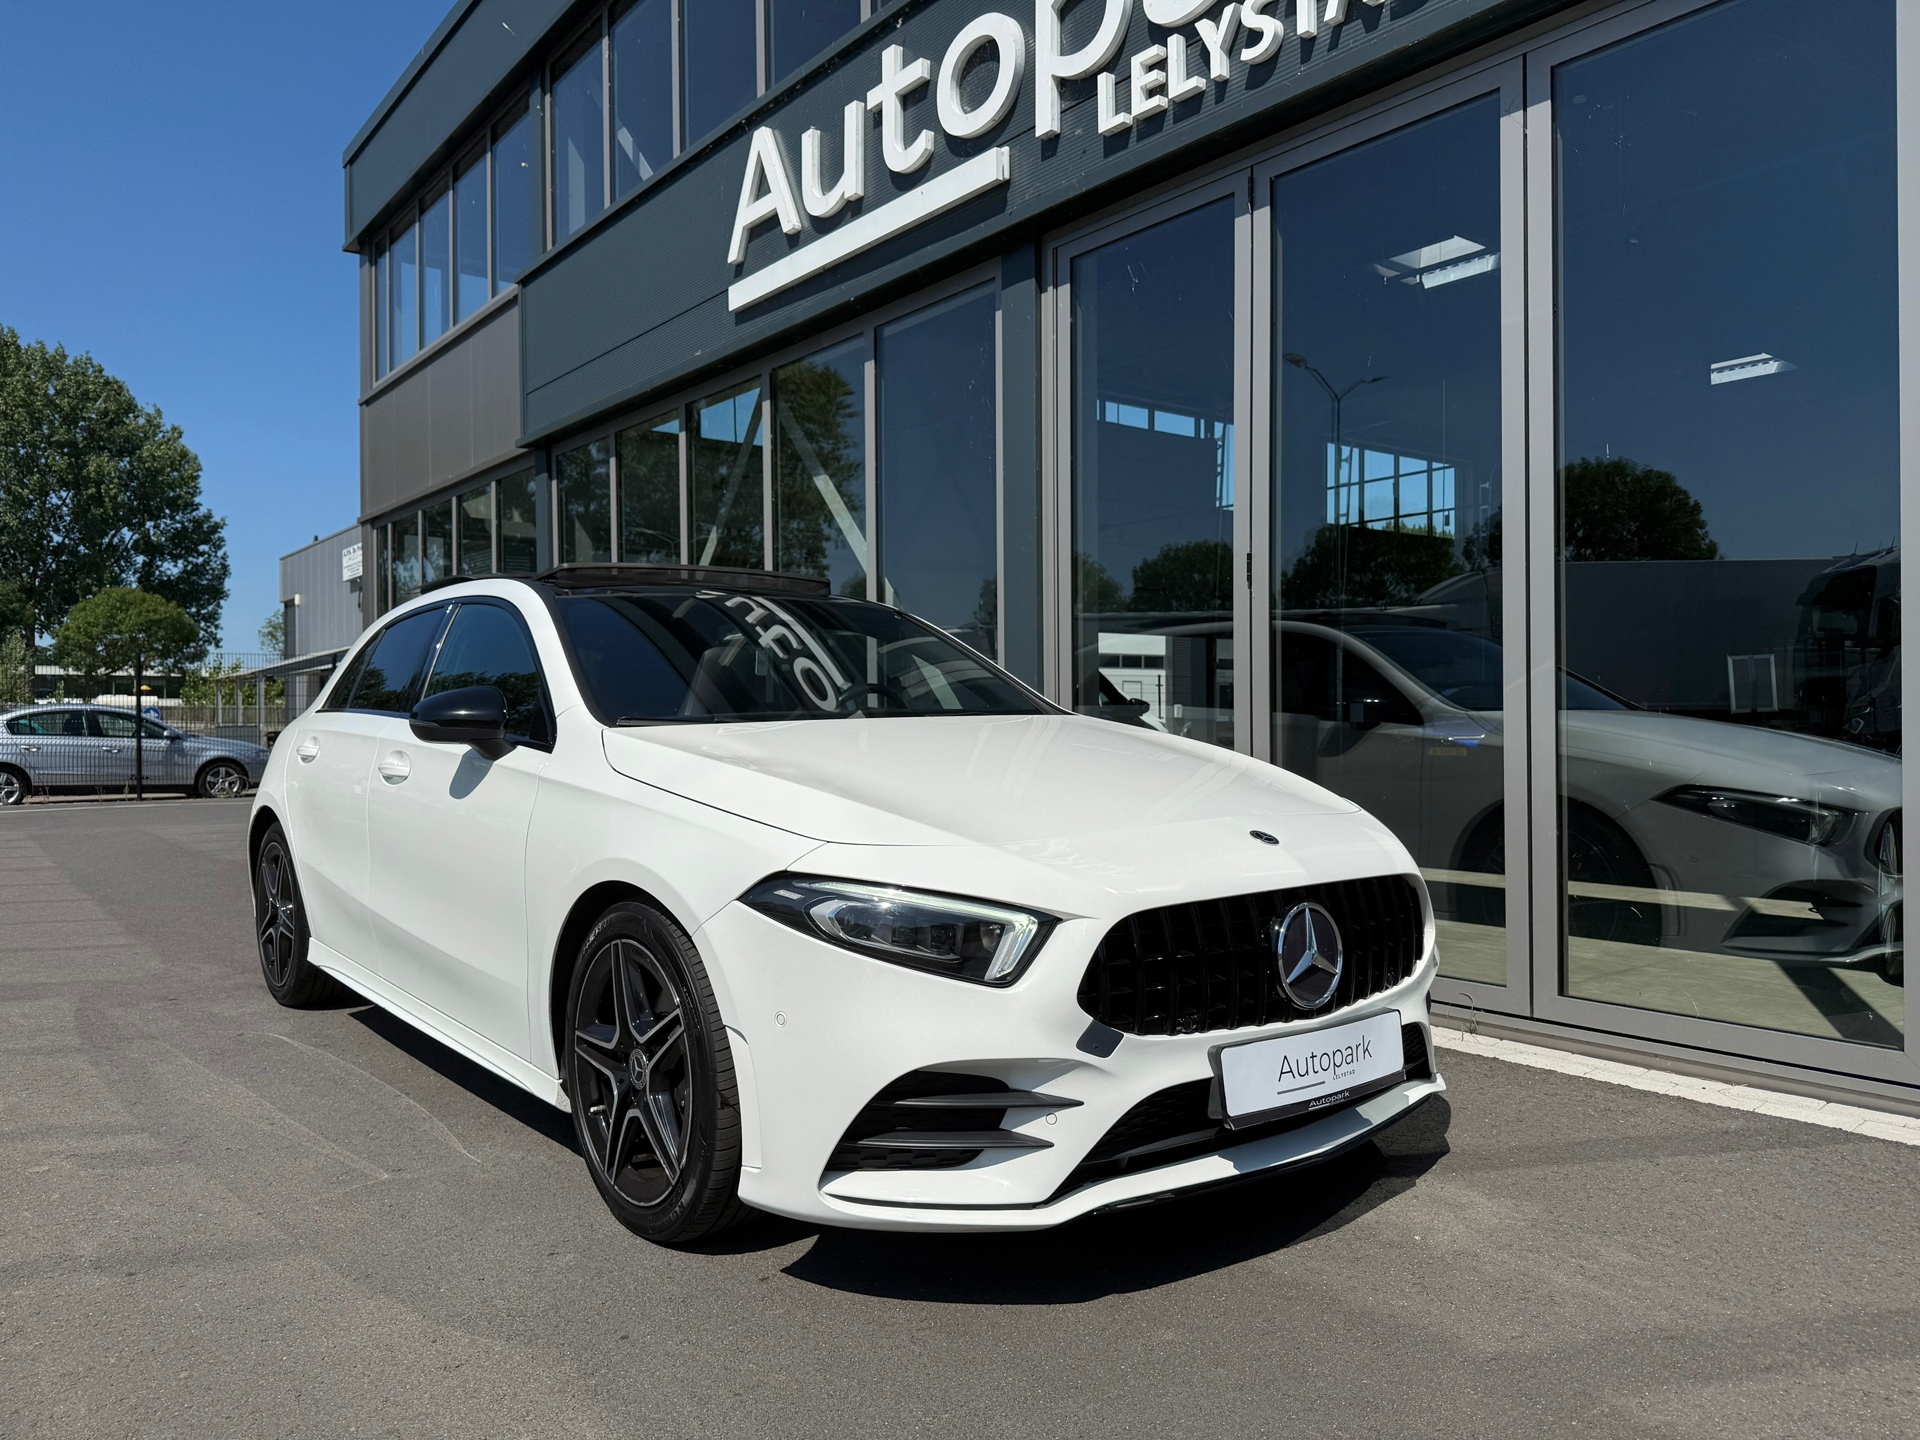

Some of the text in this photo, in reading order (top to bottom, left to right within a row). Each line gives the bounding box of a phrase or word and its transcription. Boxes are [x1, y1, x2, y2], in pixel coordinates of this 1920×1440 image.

[1097, 0, 1386, 138] LELYS
[727, 0, 1219, 265] Autop
[1277, 1034, 1373, 1083] Autopark
[1332, 1069, 1356, 1081] LELYSTAD
[1309, 1090, 1350, 1107] Autopark
